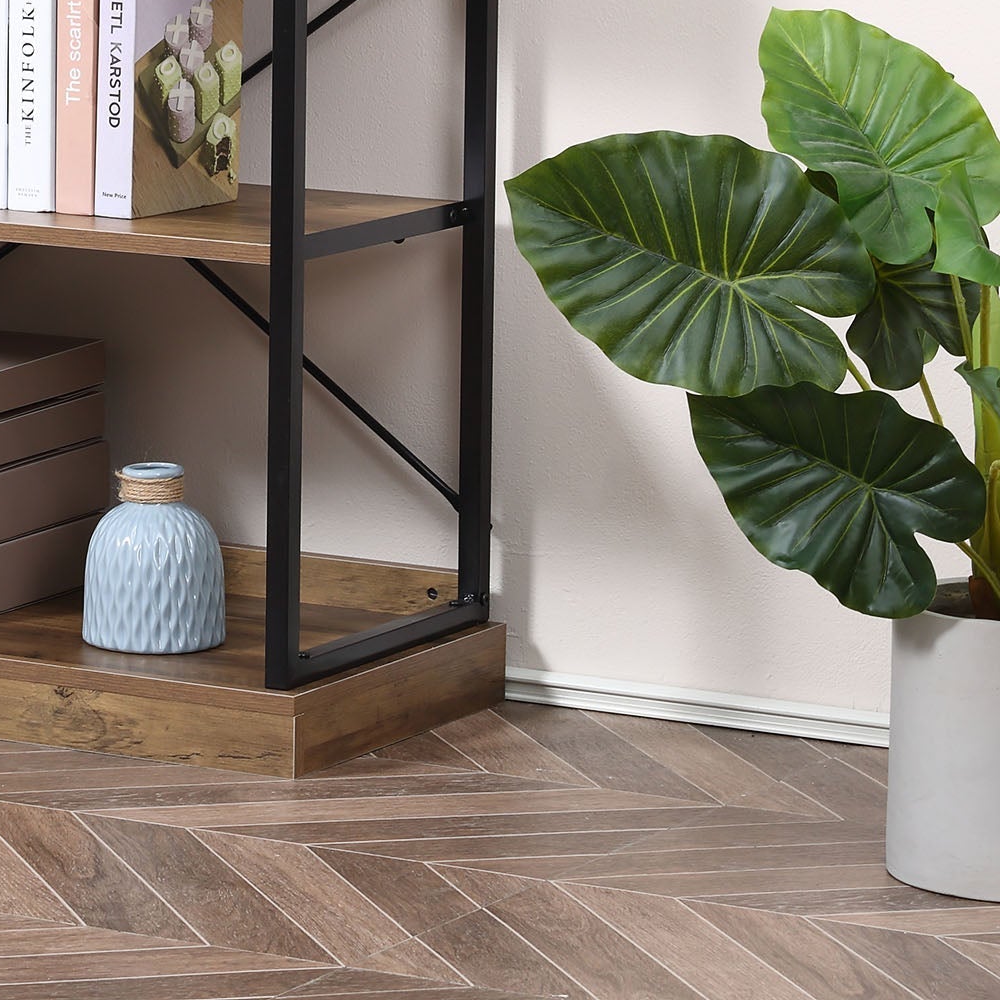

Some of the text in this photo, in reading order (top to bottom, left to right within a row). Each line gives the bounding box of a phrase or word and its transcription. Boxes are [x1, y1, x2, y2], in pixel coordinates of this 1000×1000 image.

[21, 7, 35, 122] KINFOLK
[65, 67, 81, 106] The
[108, 42, 122, 129] KARSTOD
[24, 124, 32, 145] THE
